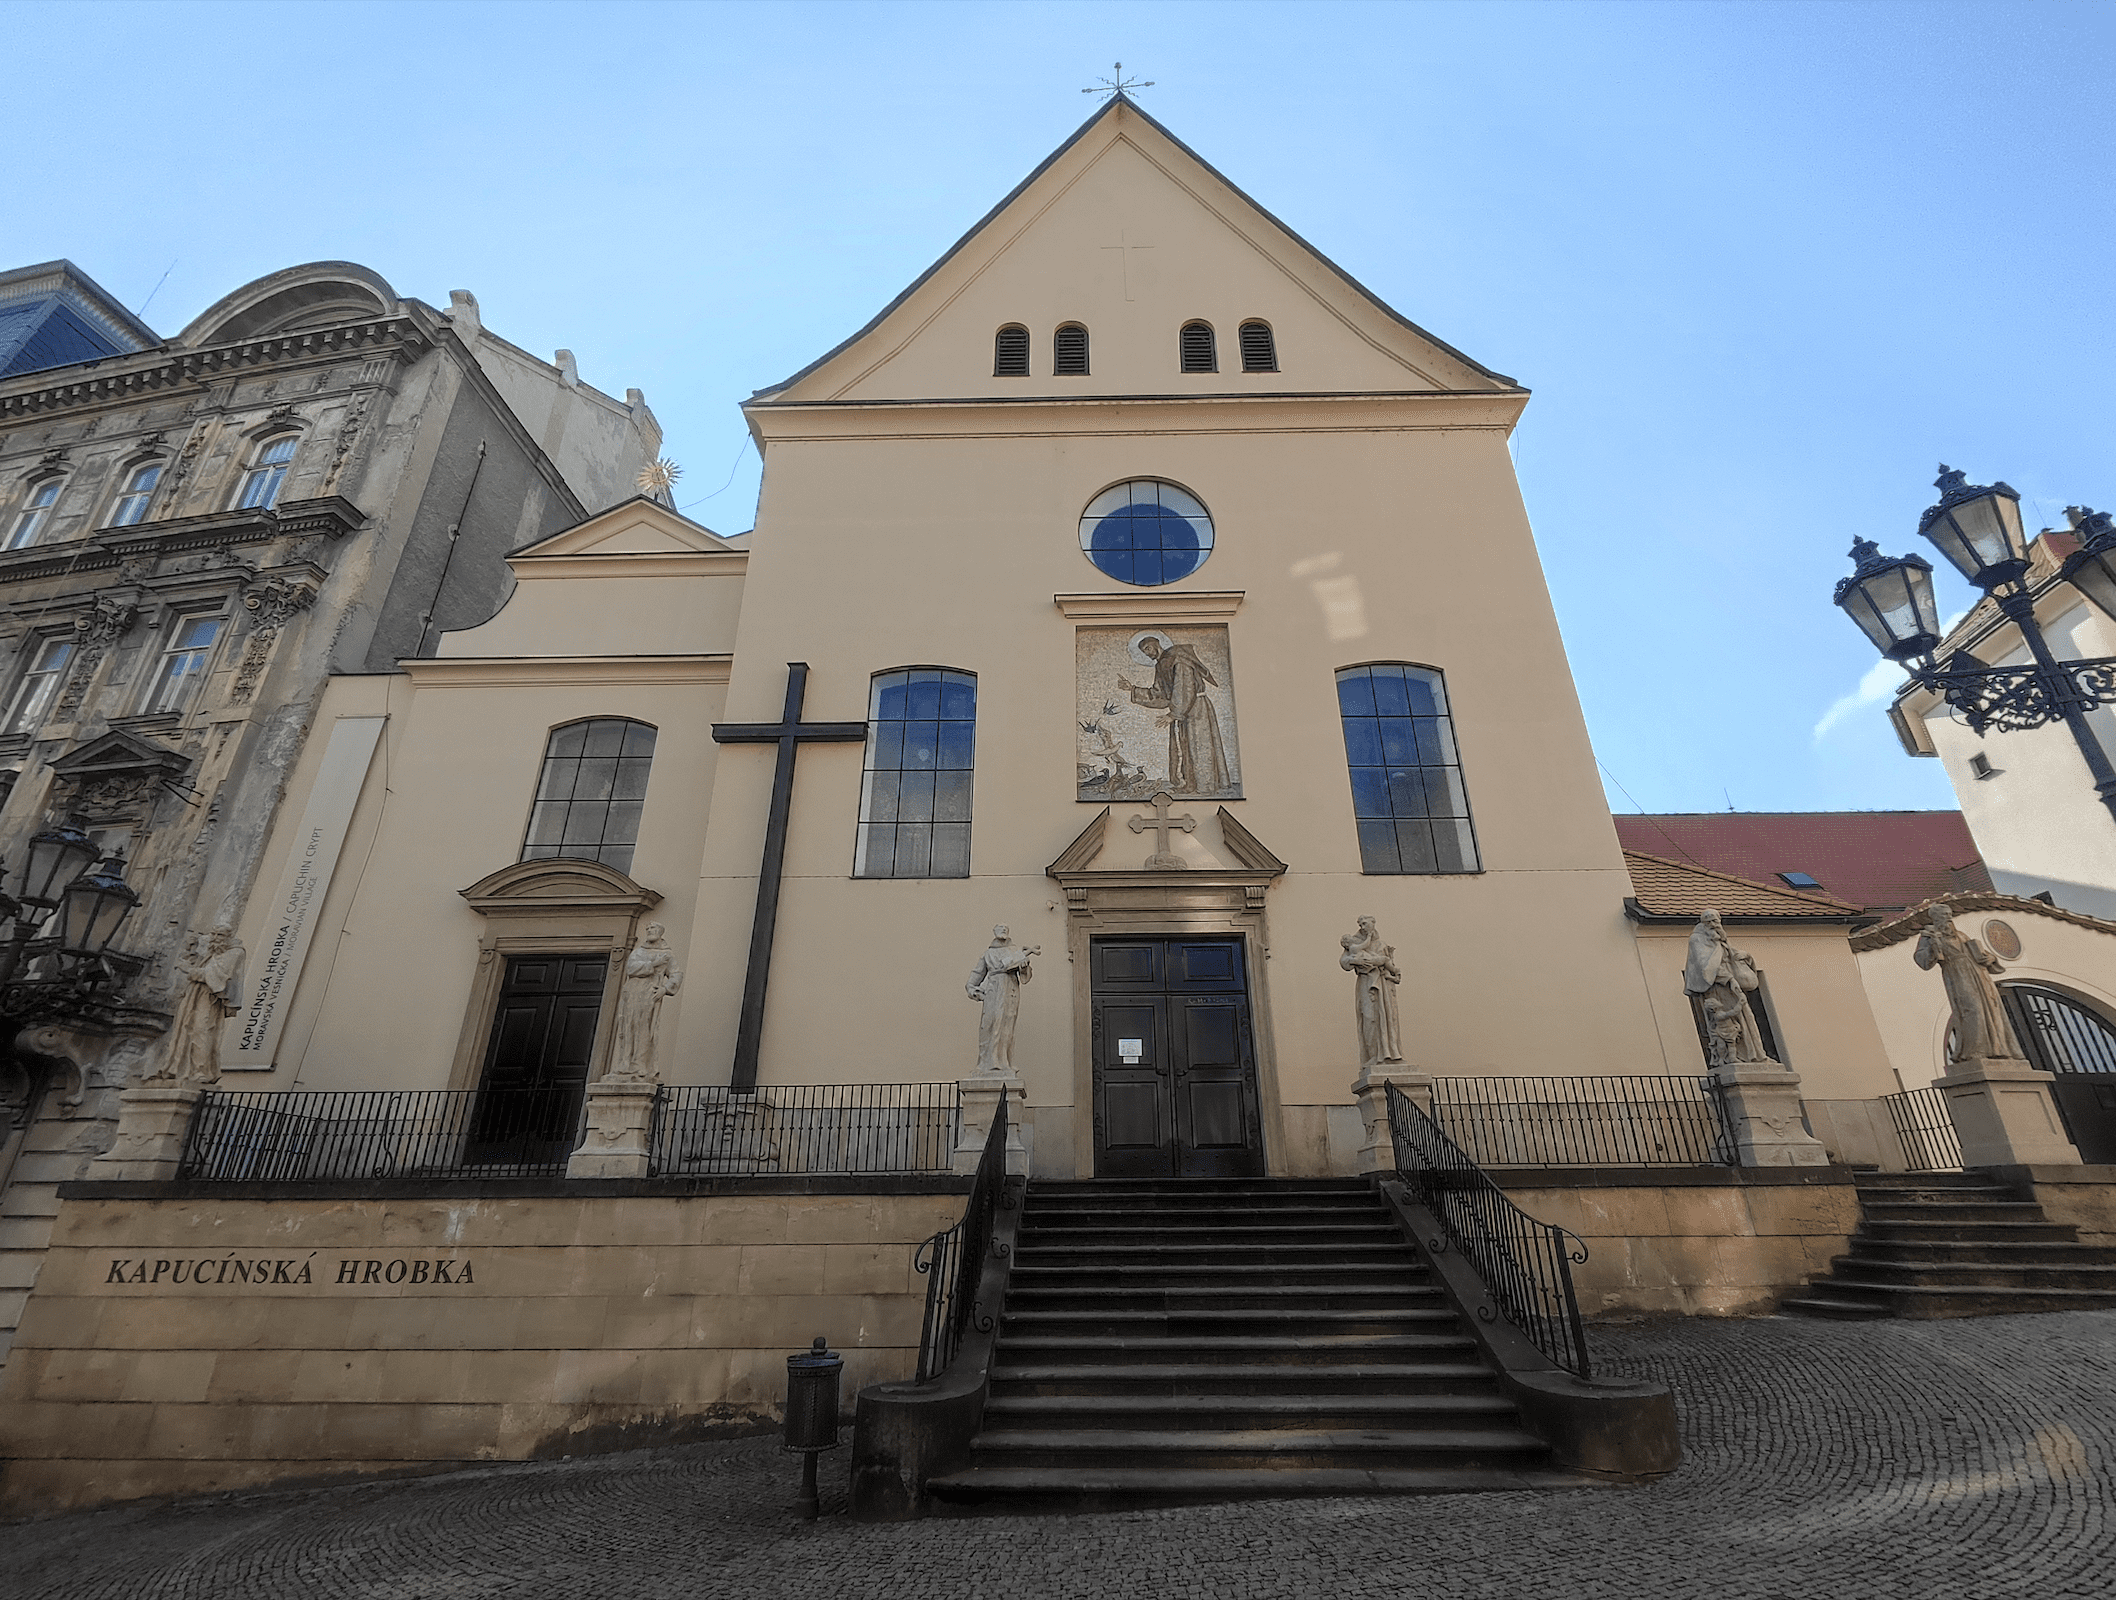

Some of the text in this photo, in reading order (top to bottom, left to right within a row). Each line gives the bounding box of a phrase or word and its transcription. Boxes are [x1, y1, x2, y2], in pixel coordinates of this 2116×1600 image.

[239, 976, 273, 1050] KAPUCÍNSKÁ
[265, 925, 290, 972] HROBKA
[286, 860, 312, 913] CAPUCHIN
[306, 827, 323, 857] CRYPT
[253, 1002, 275, 1050] MORAVSKÁ
[269, 959, 290, 1000] VESNIČKA
[287, 908, 307, 950] MORAVIAN
[301, 877, 318, 907] VILLAGE
[105, 1251, 474, 1284] KAPUCÍNSKÁ HROBKA
